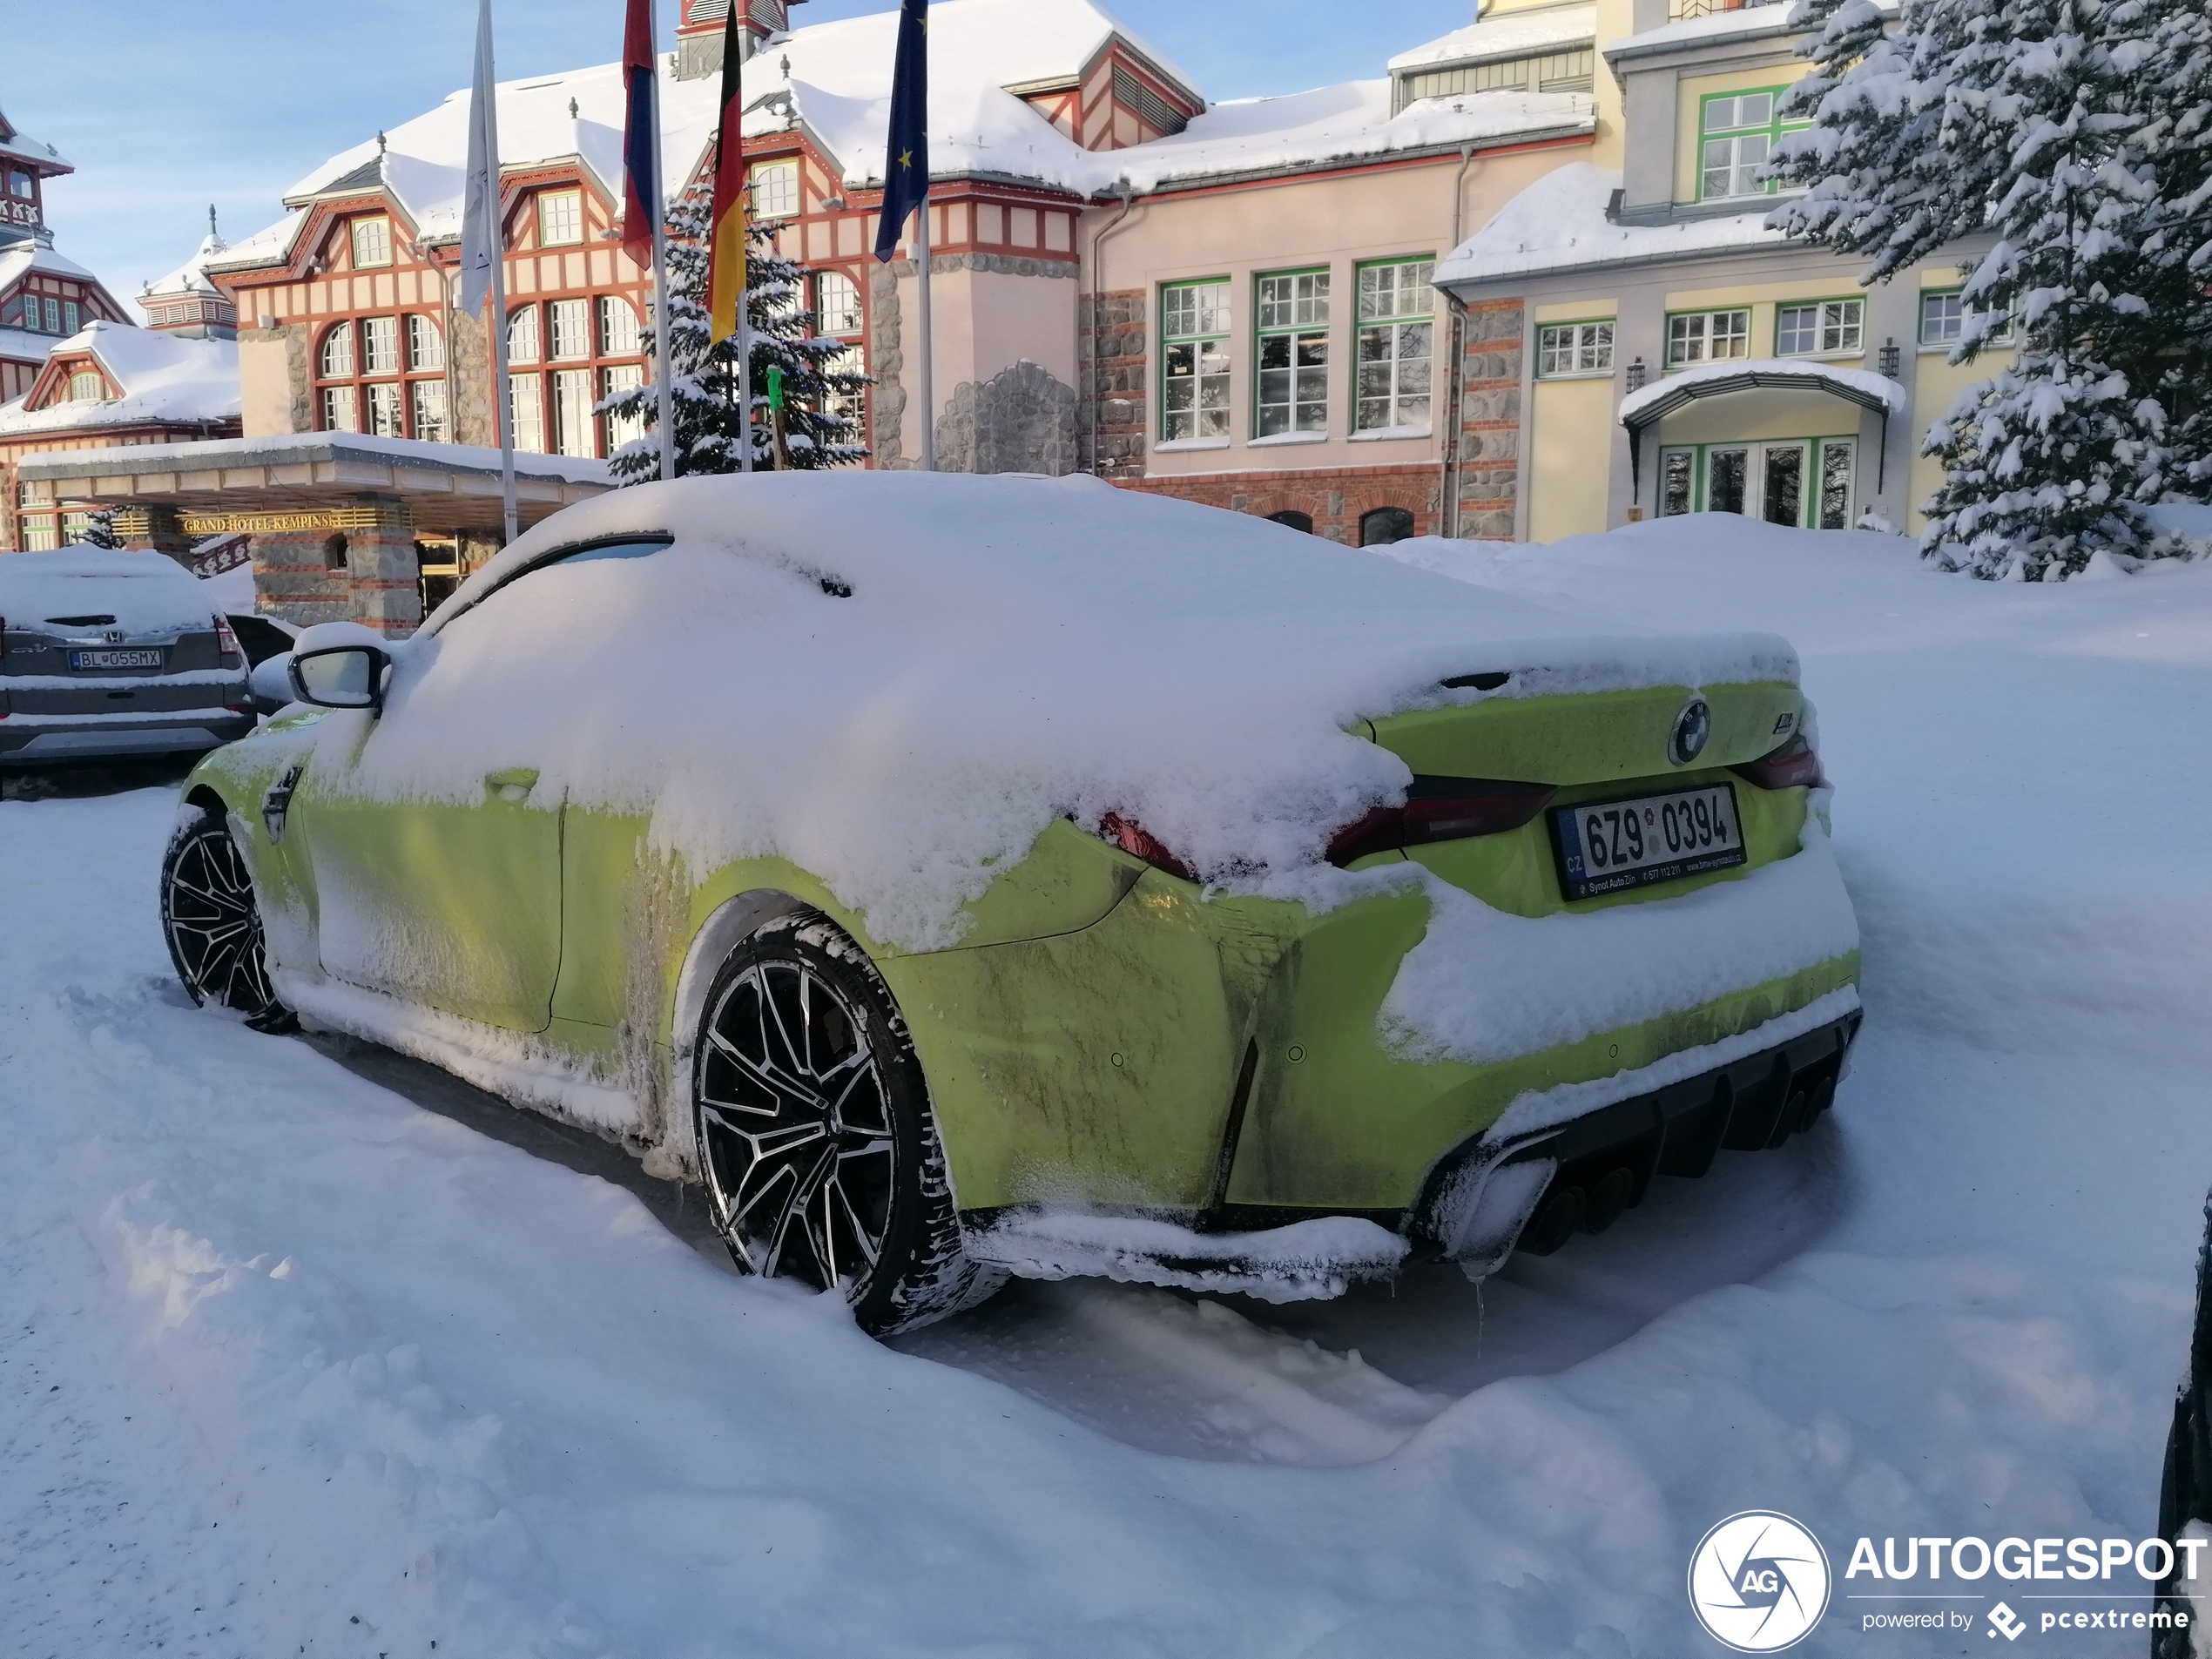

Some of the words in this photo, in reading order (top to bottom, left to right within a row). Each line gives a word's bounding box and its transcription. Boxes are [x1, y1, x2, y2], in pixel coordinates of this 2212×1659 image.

[184, 519, 226, 532] GRAND
[228, 517, 271, 530] HOTEL
[81, 651, 101, 666] BL
[110, 651, 159, 665] 055MX
[1586, 808, 1644, 868] 6Z9
[1662, 795, 1728, 853] 0394
[1567, 855, 1583, 873] CZ
[1589, 880, 1608, 894] Synot
[1609, 877, 1625, 889] Auto
